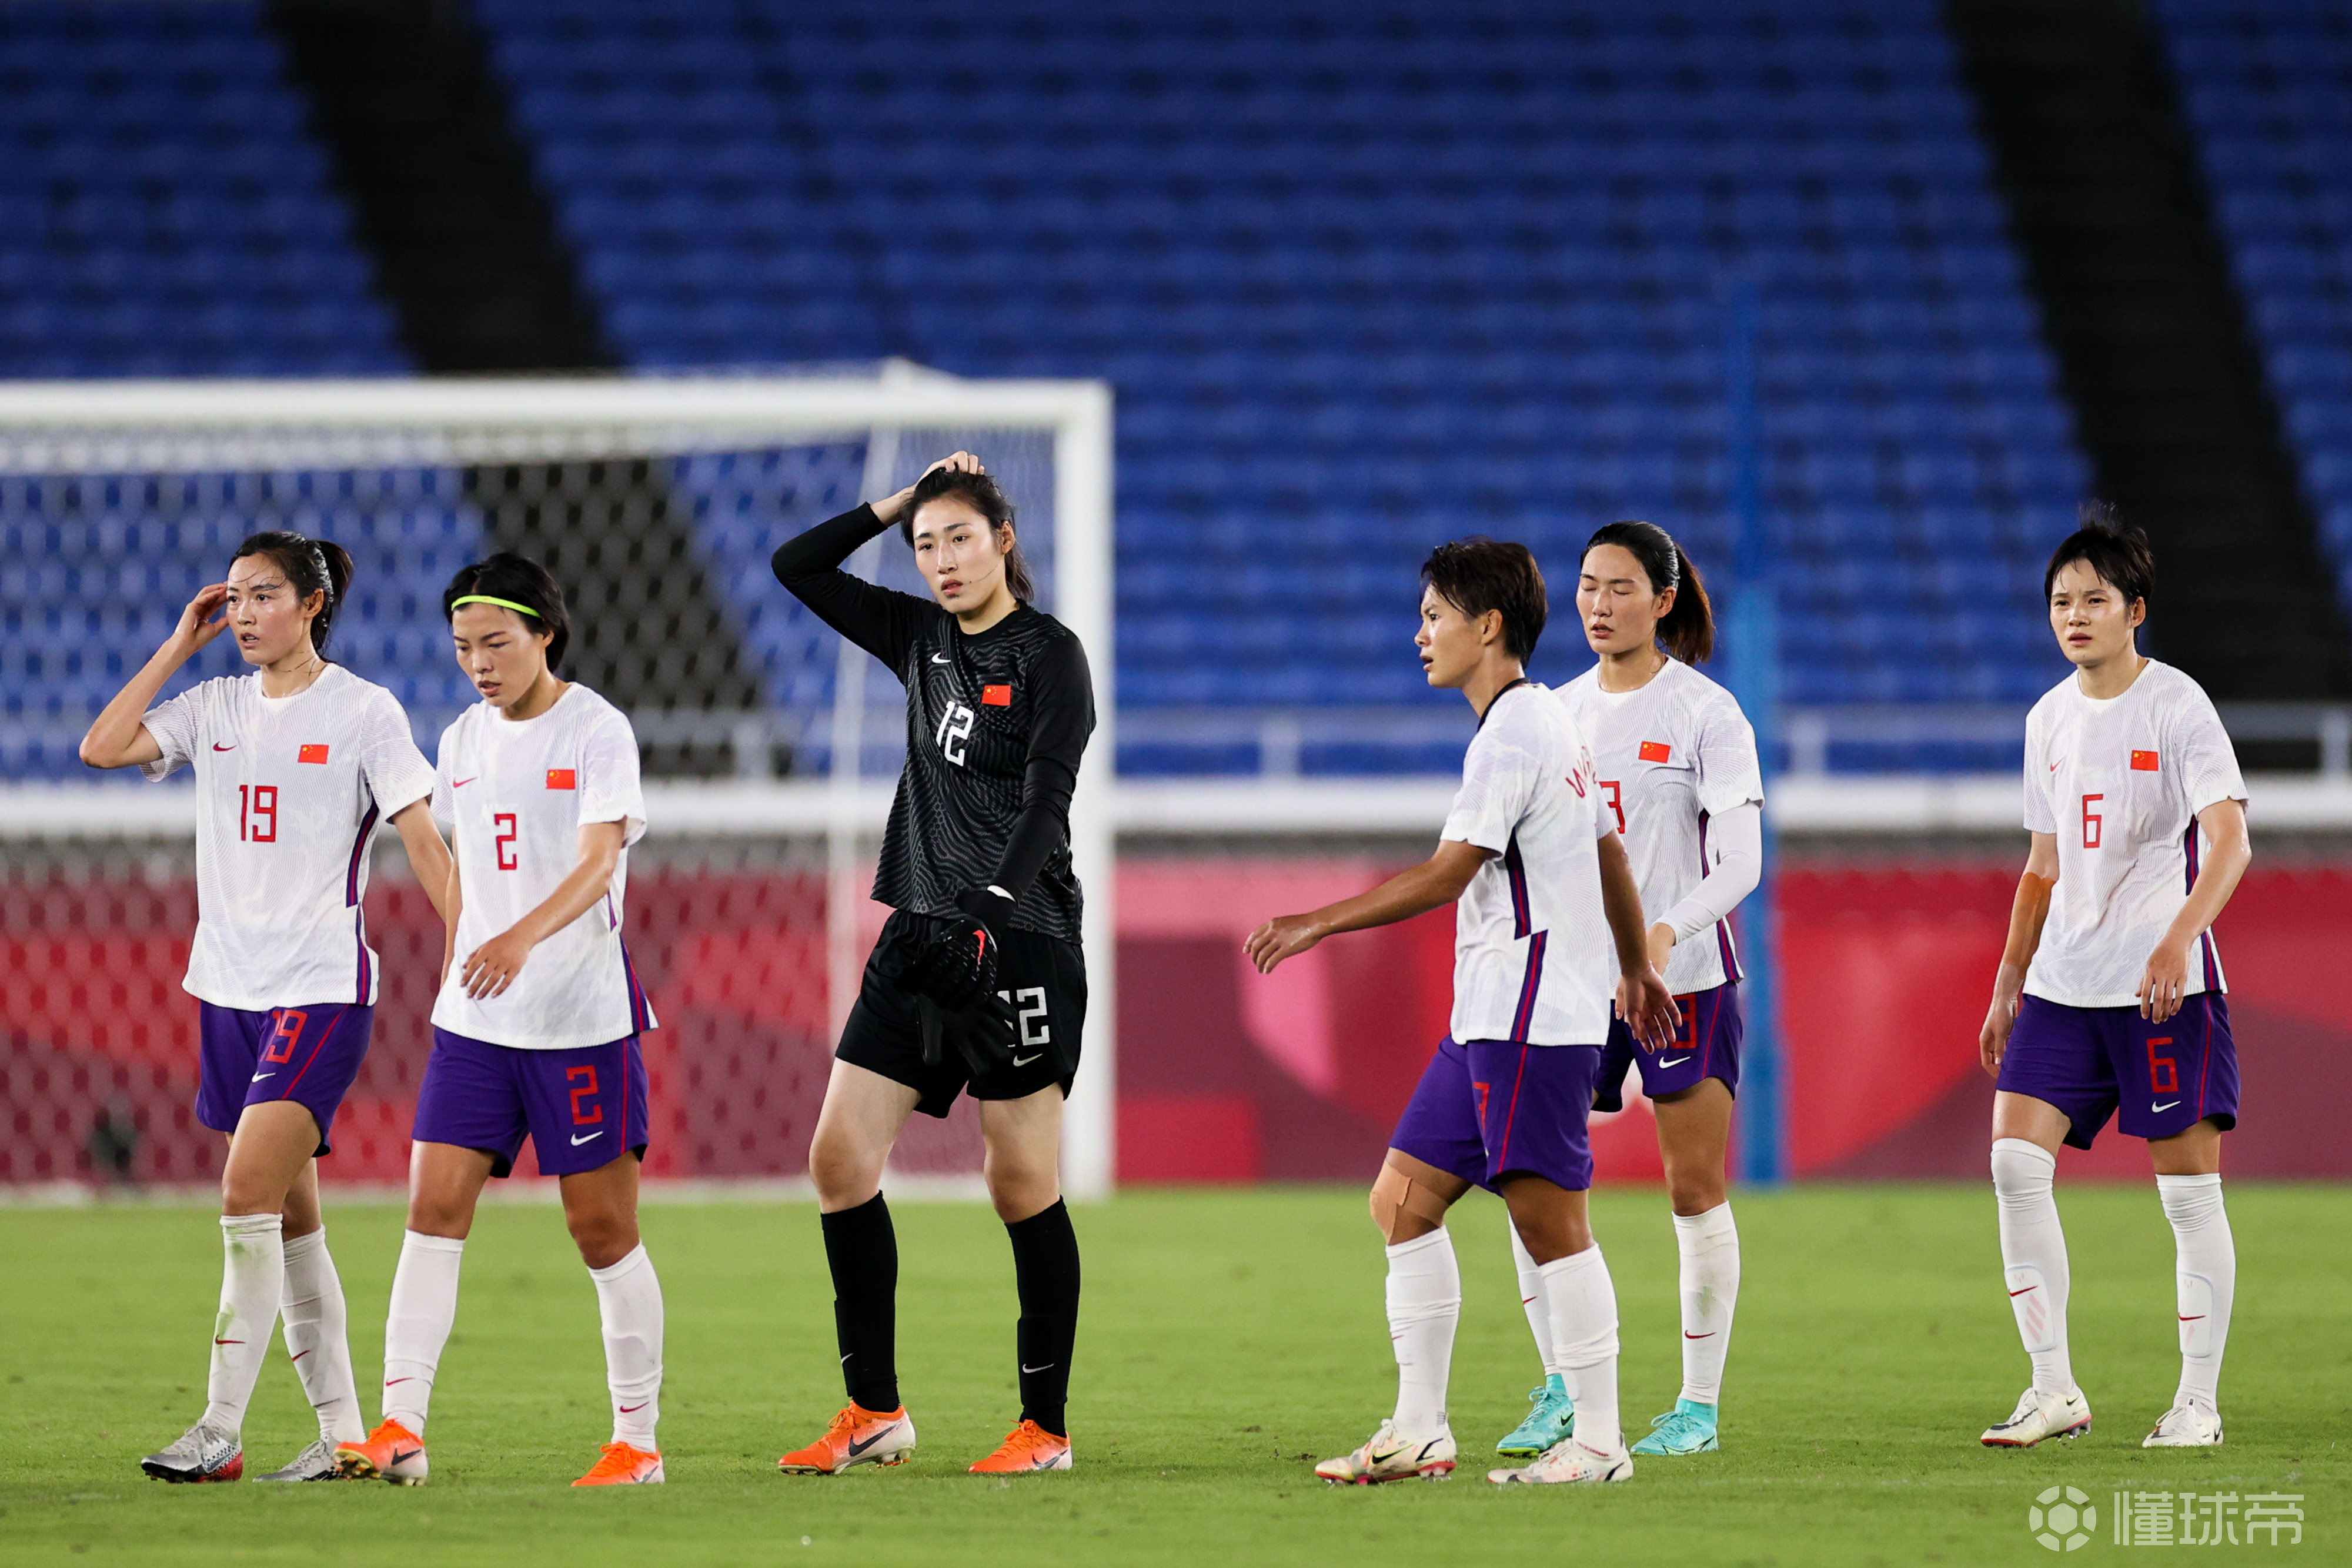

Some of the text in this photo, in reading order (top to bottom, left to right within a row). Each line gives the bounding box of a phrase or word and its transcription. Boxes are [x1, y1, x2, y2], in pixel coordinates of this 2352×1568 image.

[936, 701, 974, 767] 12
[239, 785, 278, 842] 19
[494, 813, 517, 870] 2
[2082, 794, 2103, 848] 6
[259, 1009, 308, 1064] 19
[2147, 1037, 2179, 1093] 6
[566, 1065, 603, 1125] 2
